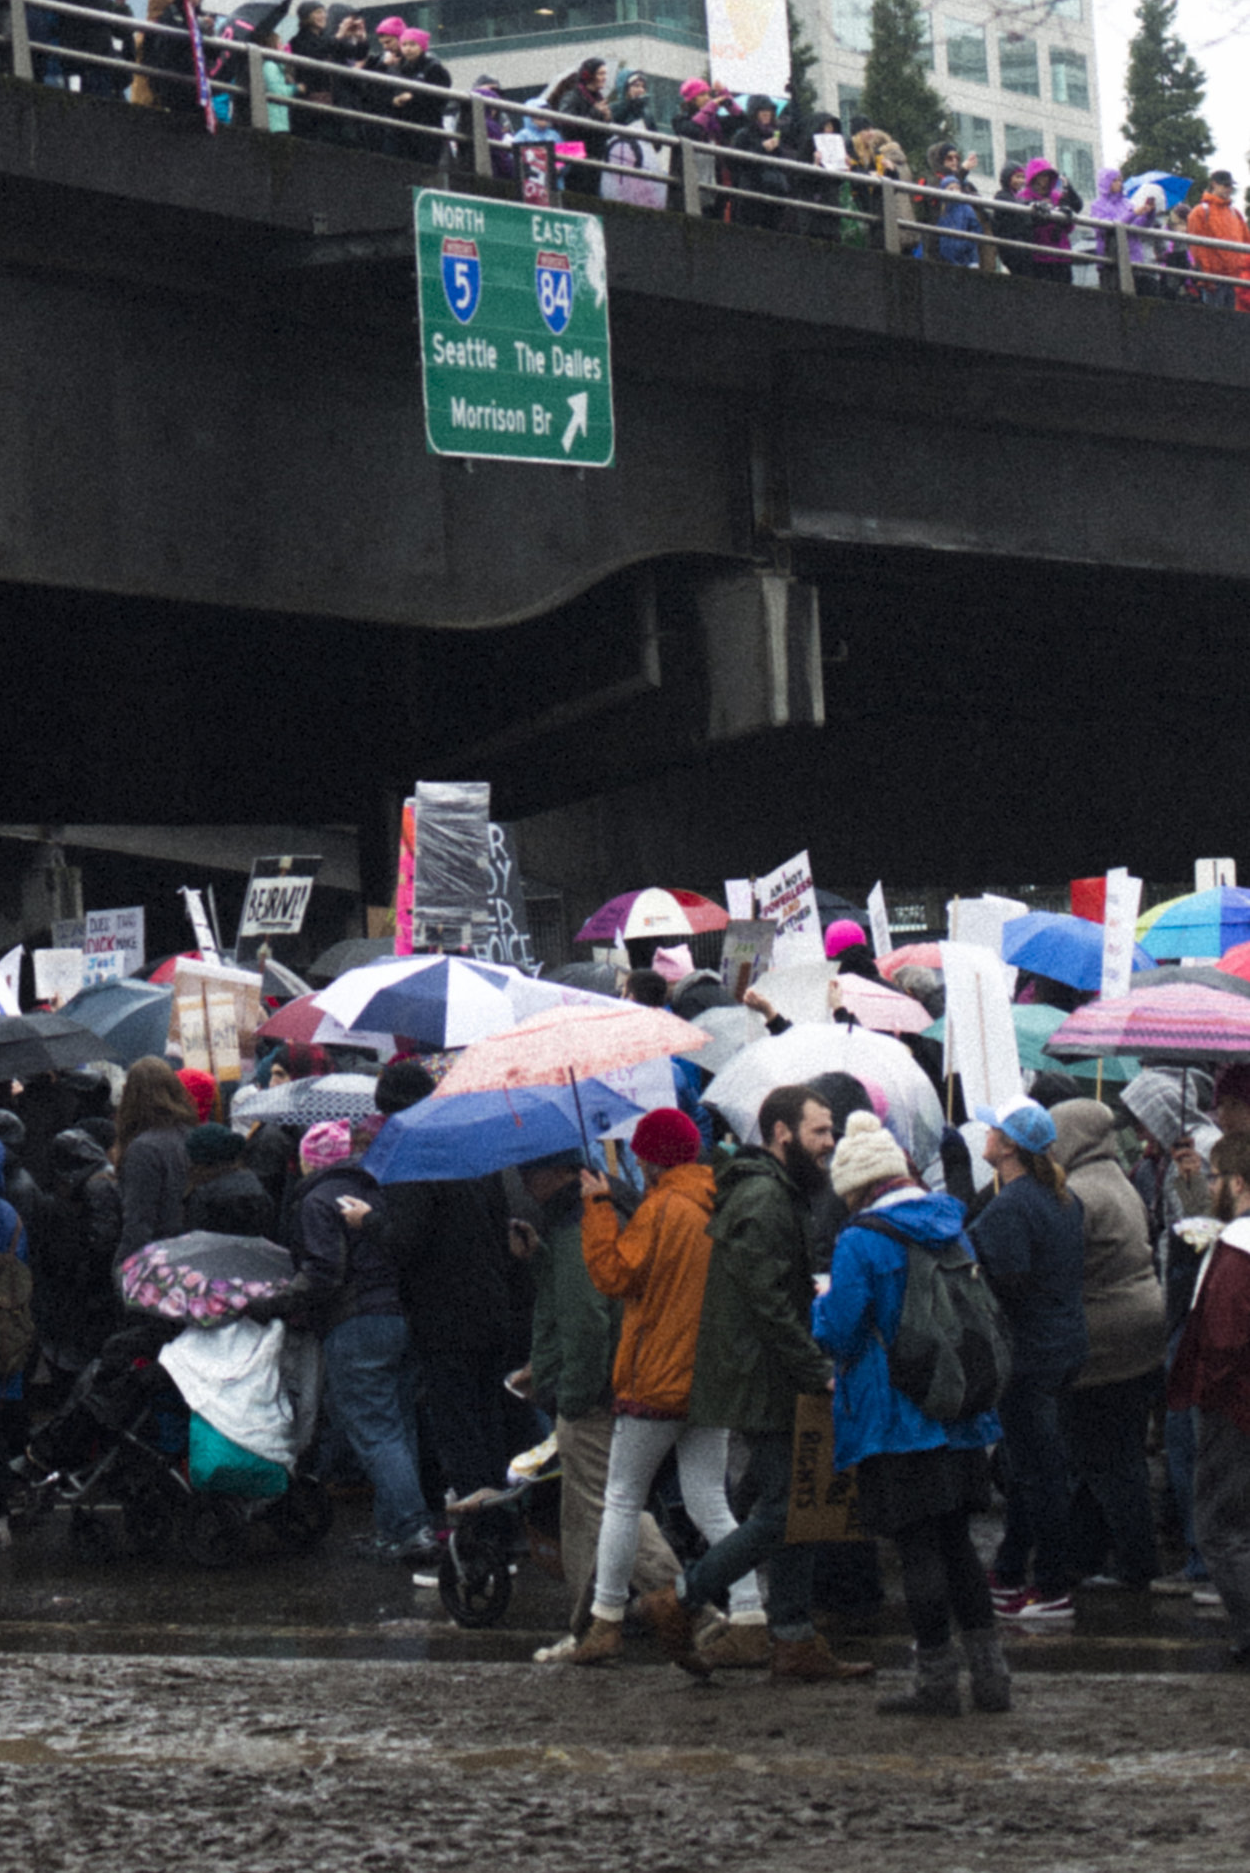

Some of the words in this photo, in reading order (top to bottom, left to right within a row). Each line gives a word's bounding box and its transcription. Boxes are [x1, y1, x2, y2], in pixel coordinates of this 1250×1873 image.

[431, 200, 485, 234] NORTH
[531, 215, 573, 246] EAST
[454, 263, 472, 310] 5
[540, 271, 570, 319] 84
[432, 332, 498, 369] Seattle
[514, 340, 546, 375] The
[552, 345, 602, 380] Dalles
[451, 396, 526, 434] Morrison
[532, 404, 553, 435] Br
